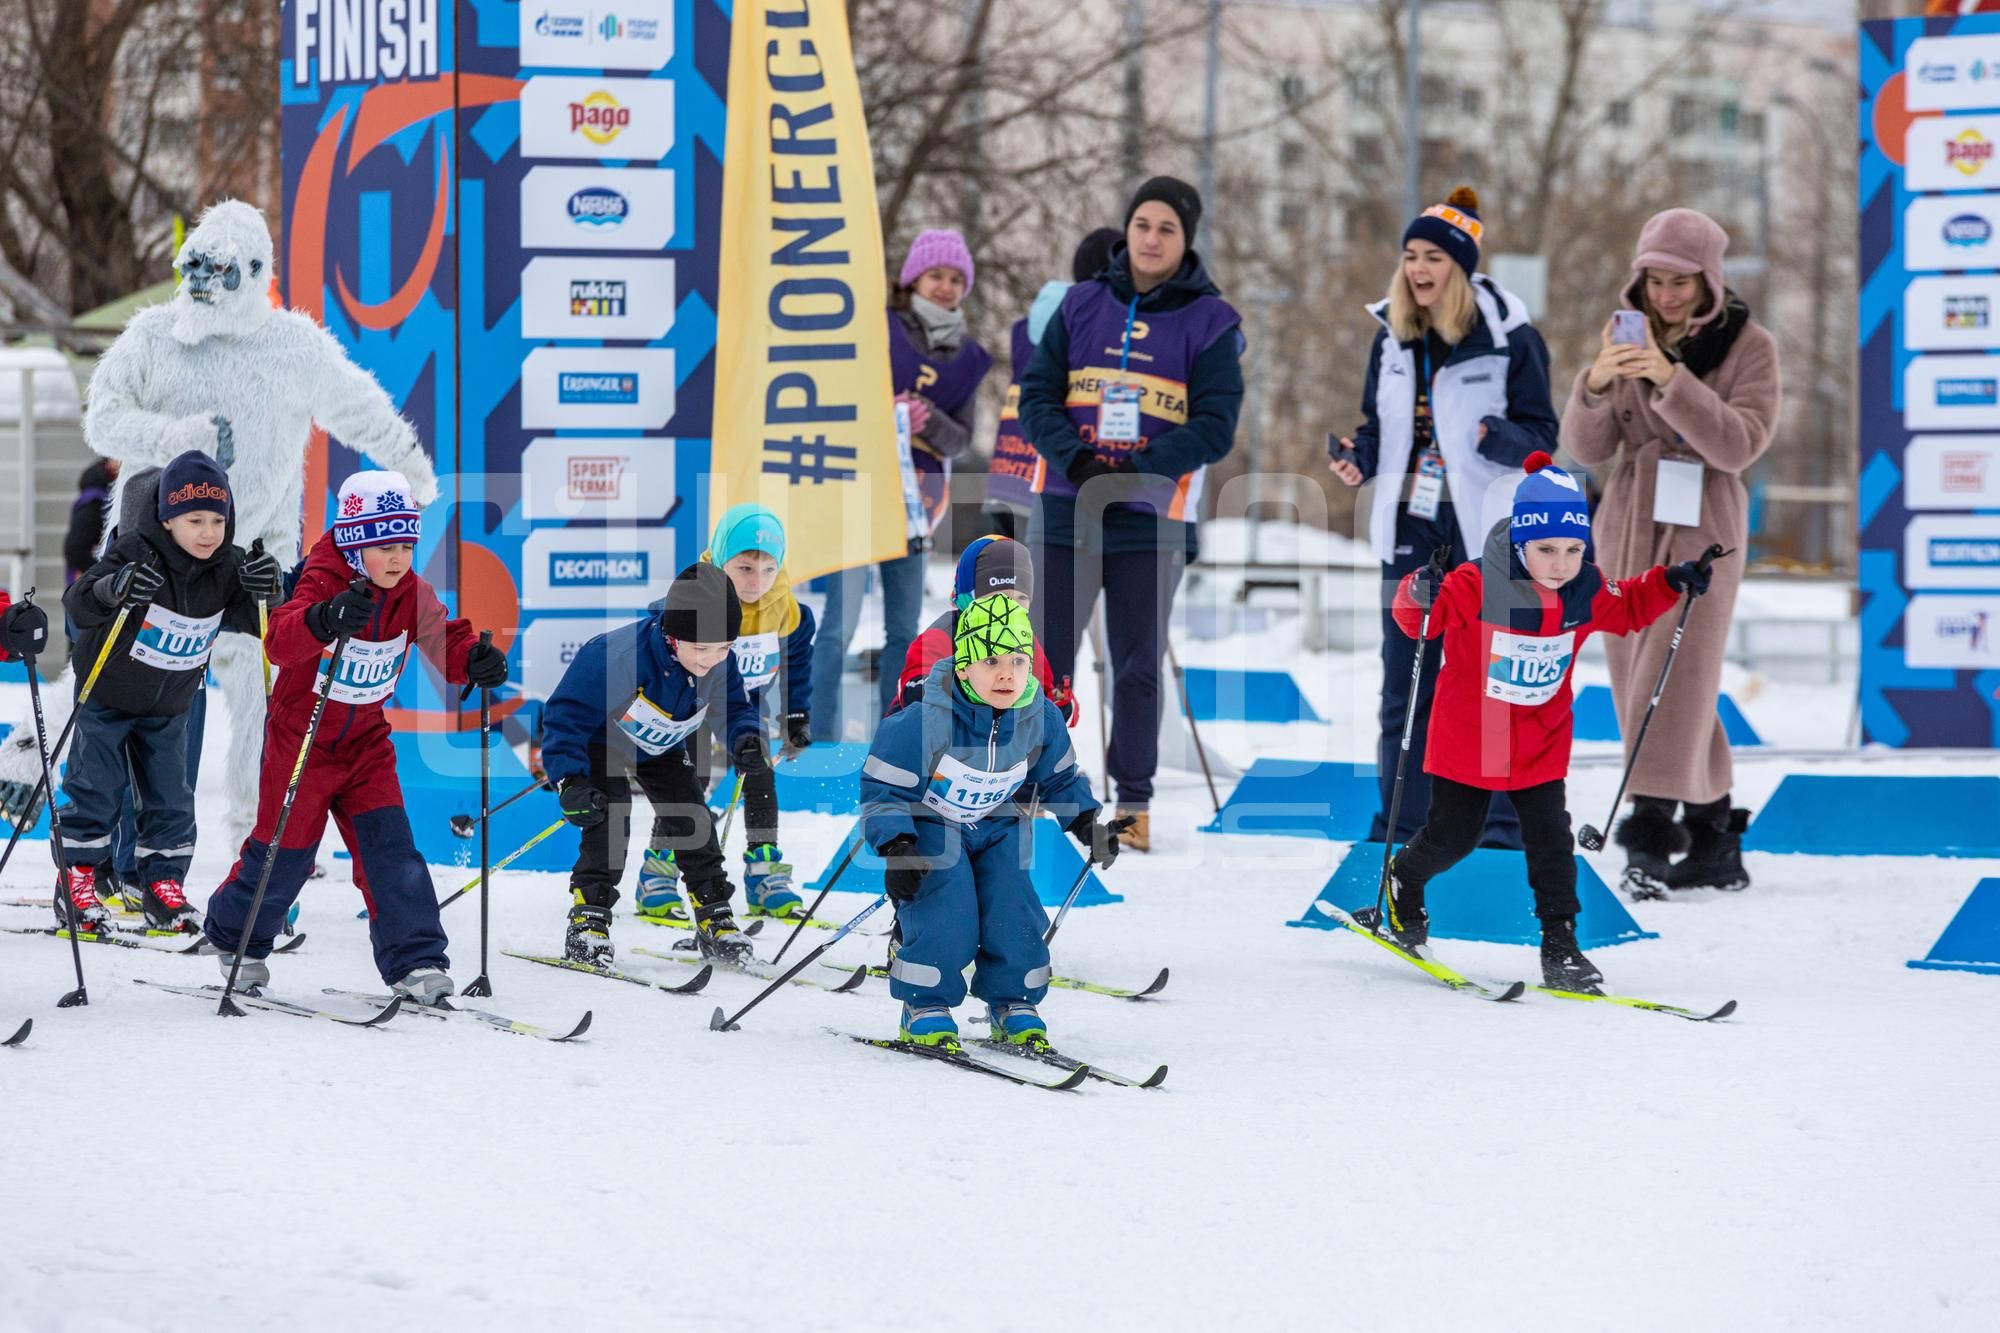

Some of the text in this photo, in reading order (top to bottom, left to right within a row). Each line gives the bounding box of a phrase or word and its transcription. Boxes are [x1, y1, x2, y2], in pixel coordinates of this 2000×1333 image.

[295, 0, 438, 83] FINISH
[568, 102, 630, 133] pago
[570, 281, 623, 299] rukka
[572, 462, 614, 477] SPORT
[167, 482, 228, 505] adidas
[572, 479, 615, 494] FERMA
[554, 559, 643, 579] DECATHLON
[156, 626, 210, 655] 1013
[340, 655, 395, 684] 1003
[1510, 655, 1561, 684] 1025
[956, 788, 1005, 805] 1136
